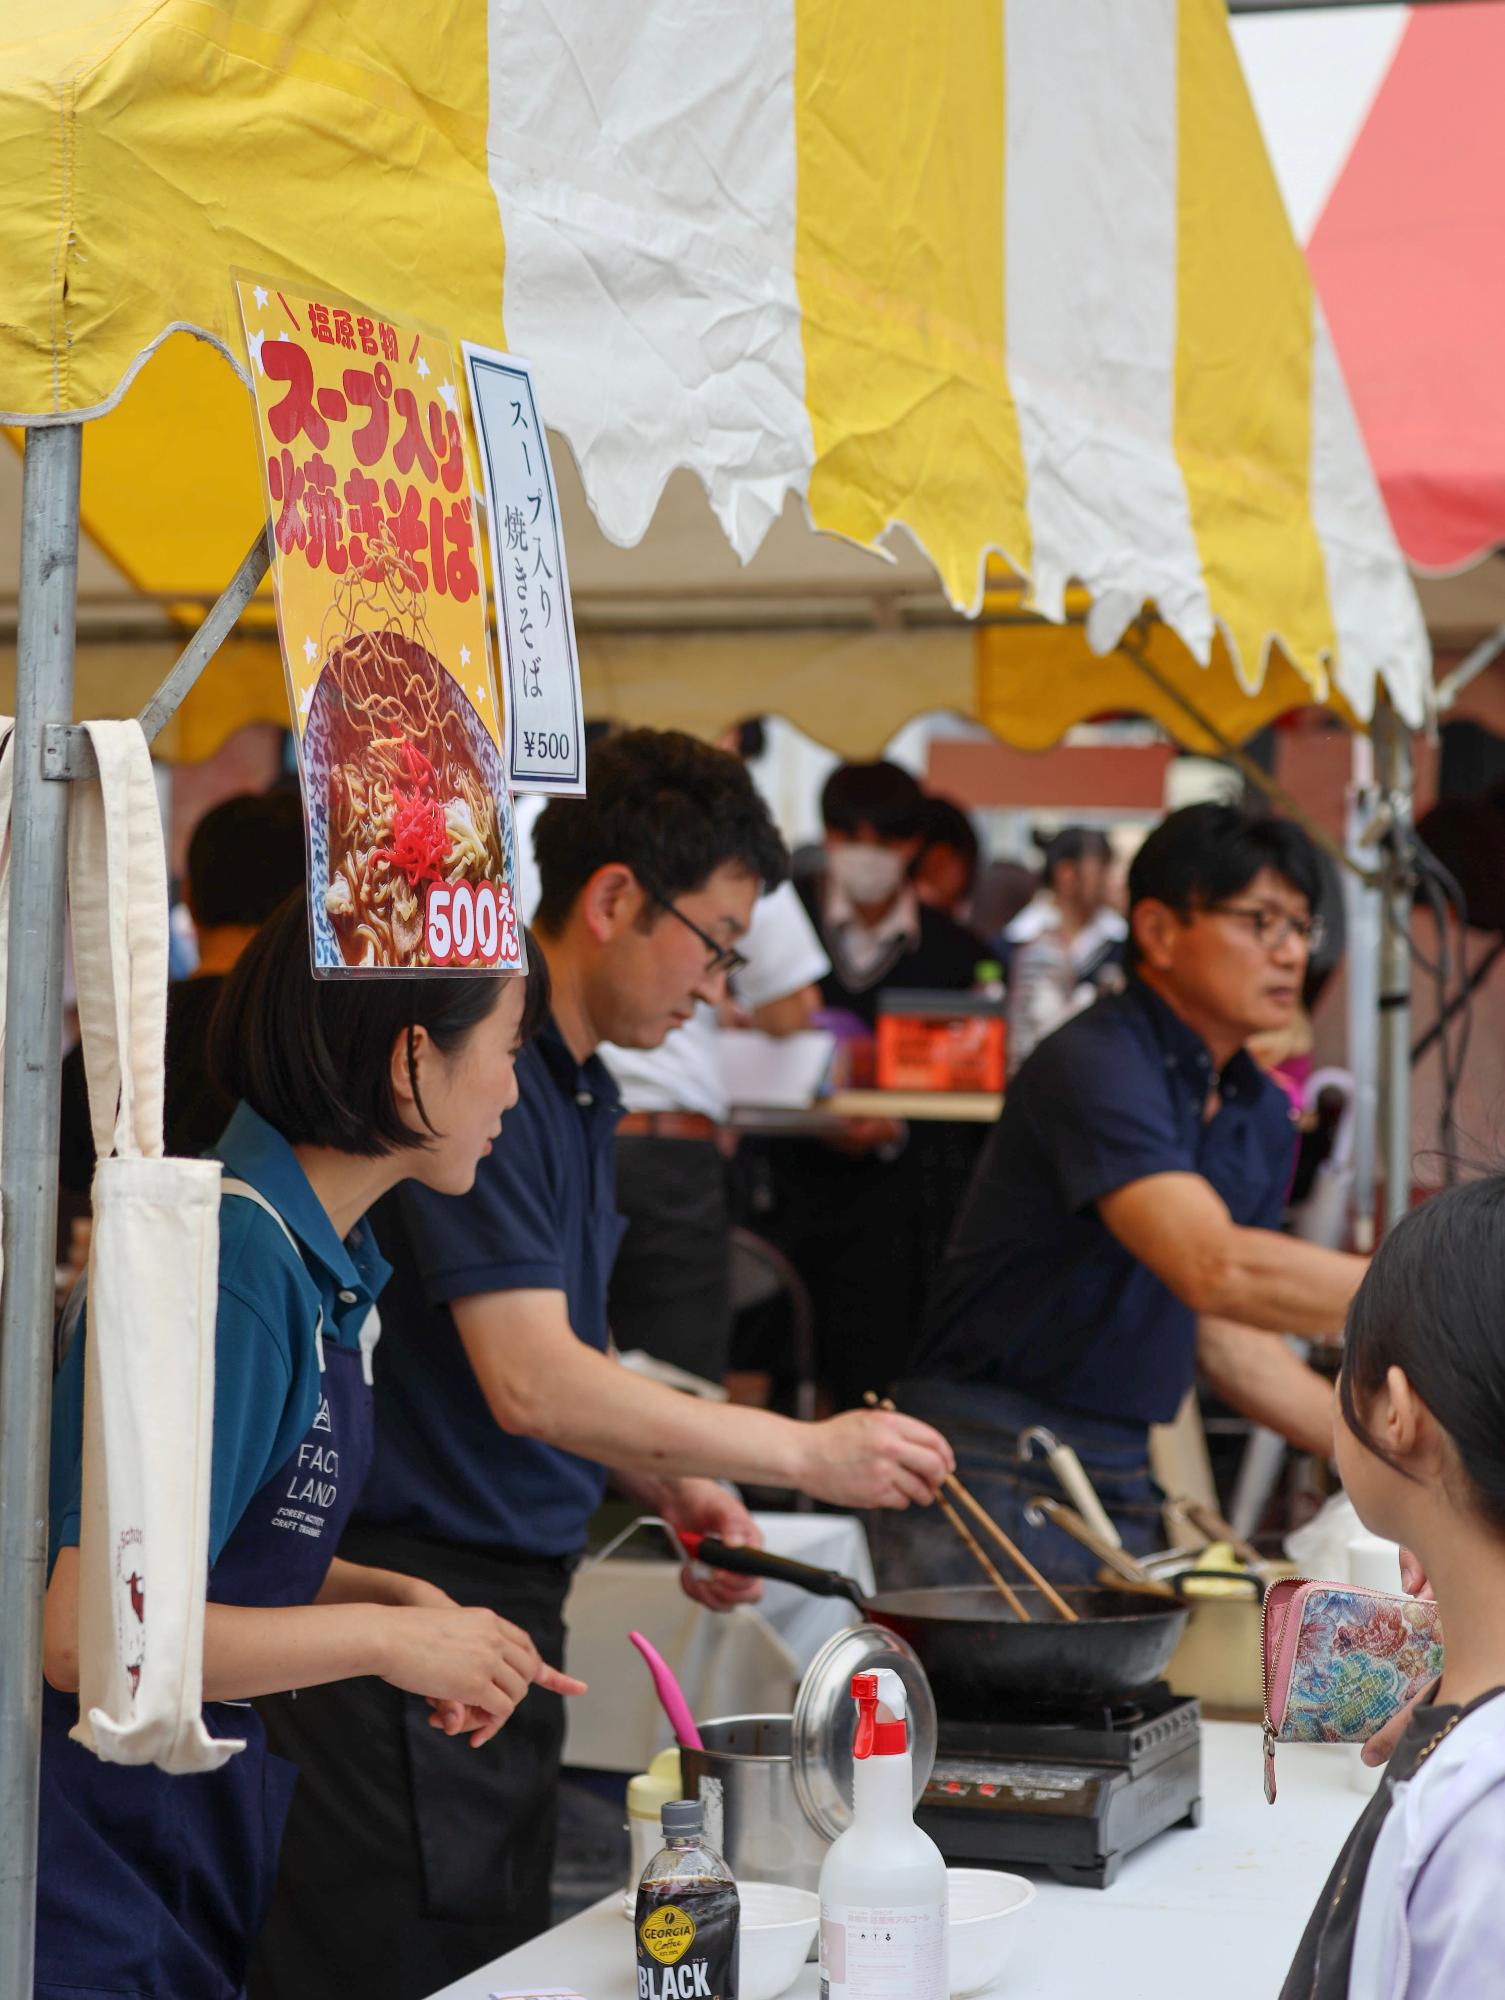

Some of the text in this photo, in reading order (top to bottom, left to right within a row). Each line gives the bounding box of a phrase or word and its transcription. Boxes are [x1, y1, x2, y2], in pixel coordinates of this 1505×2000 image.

[308, 303, 400, 363] 塩原名物
[261, 340, 464, 493] スープ入り
[267, 448, 479, 604] 焼きそば
[509, 400, 553, 629] スープ入り
[503, 504, 543, 699] 焼きそば
[523, 730, 570, 760] ¥500
[286, 1476, 337, 1508] LAND
[271, 1517, 298, 1531] CRAFT
[277, 1507, 305, 1520] FOREST
[644, 1926, 690, 1939] GEORGIA
[653, 1938, 683, 1952] Coffee
[637, 1962, 712, 2000] BLACK
